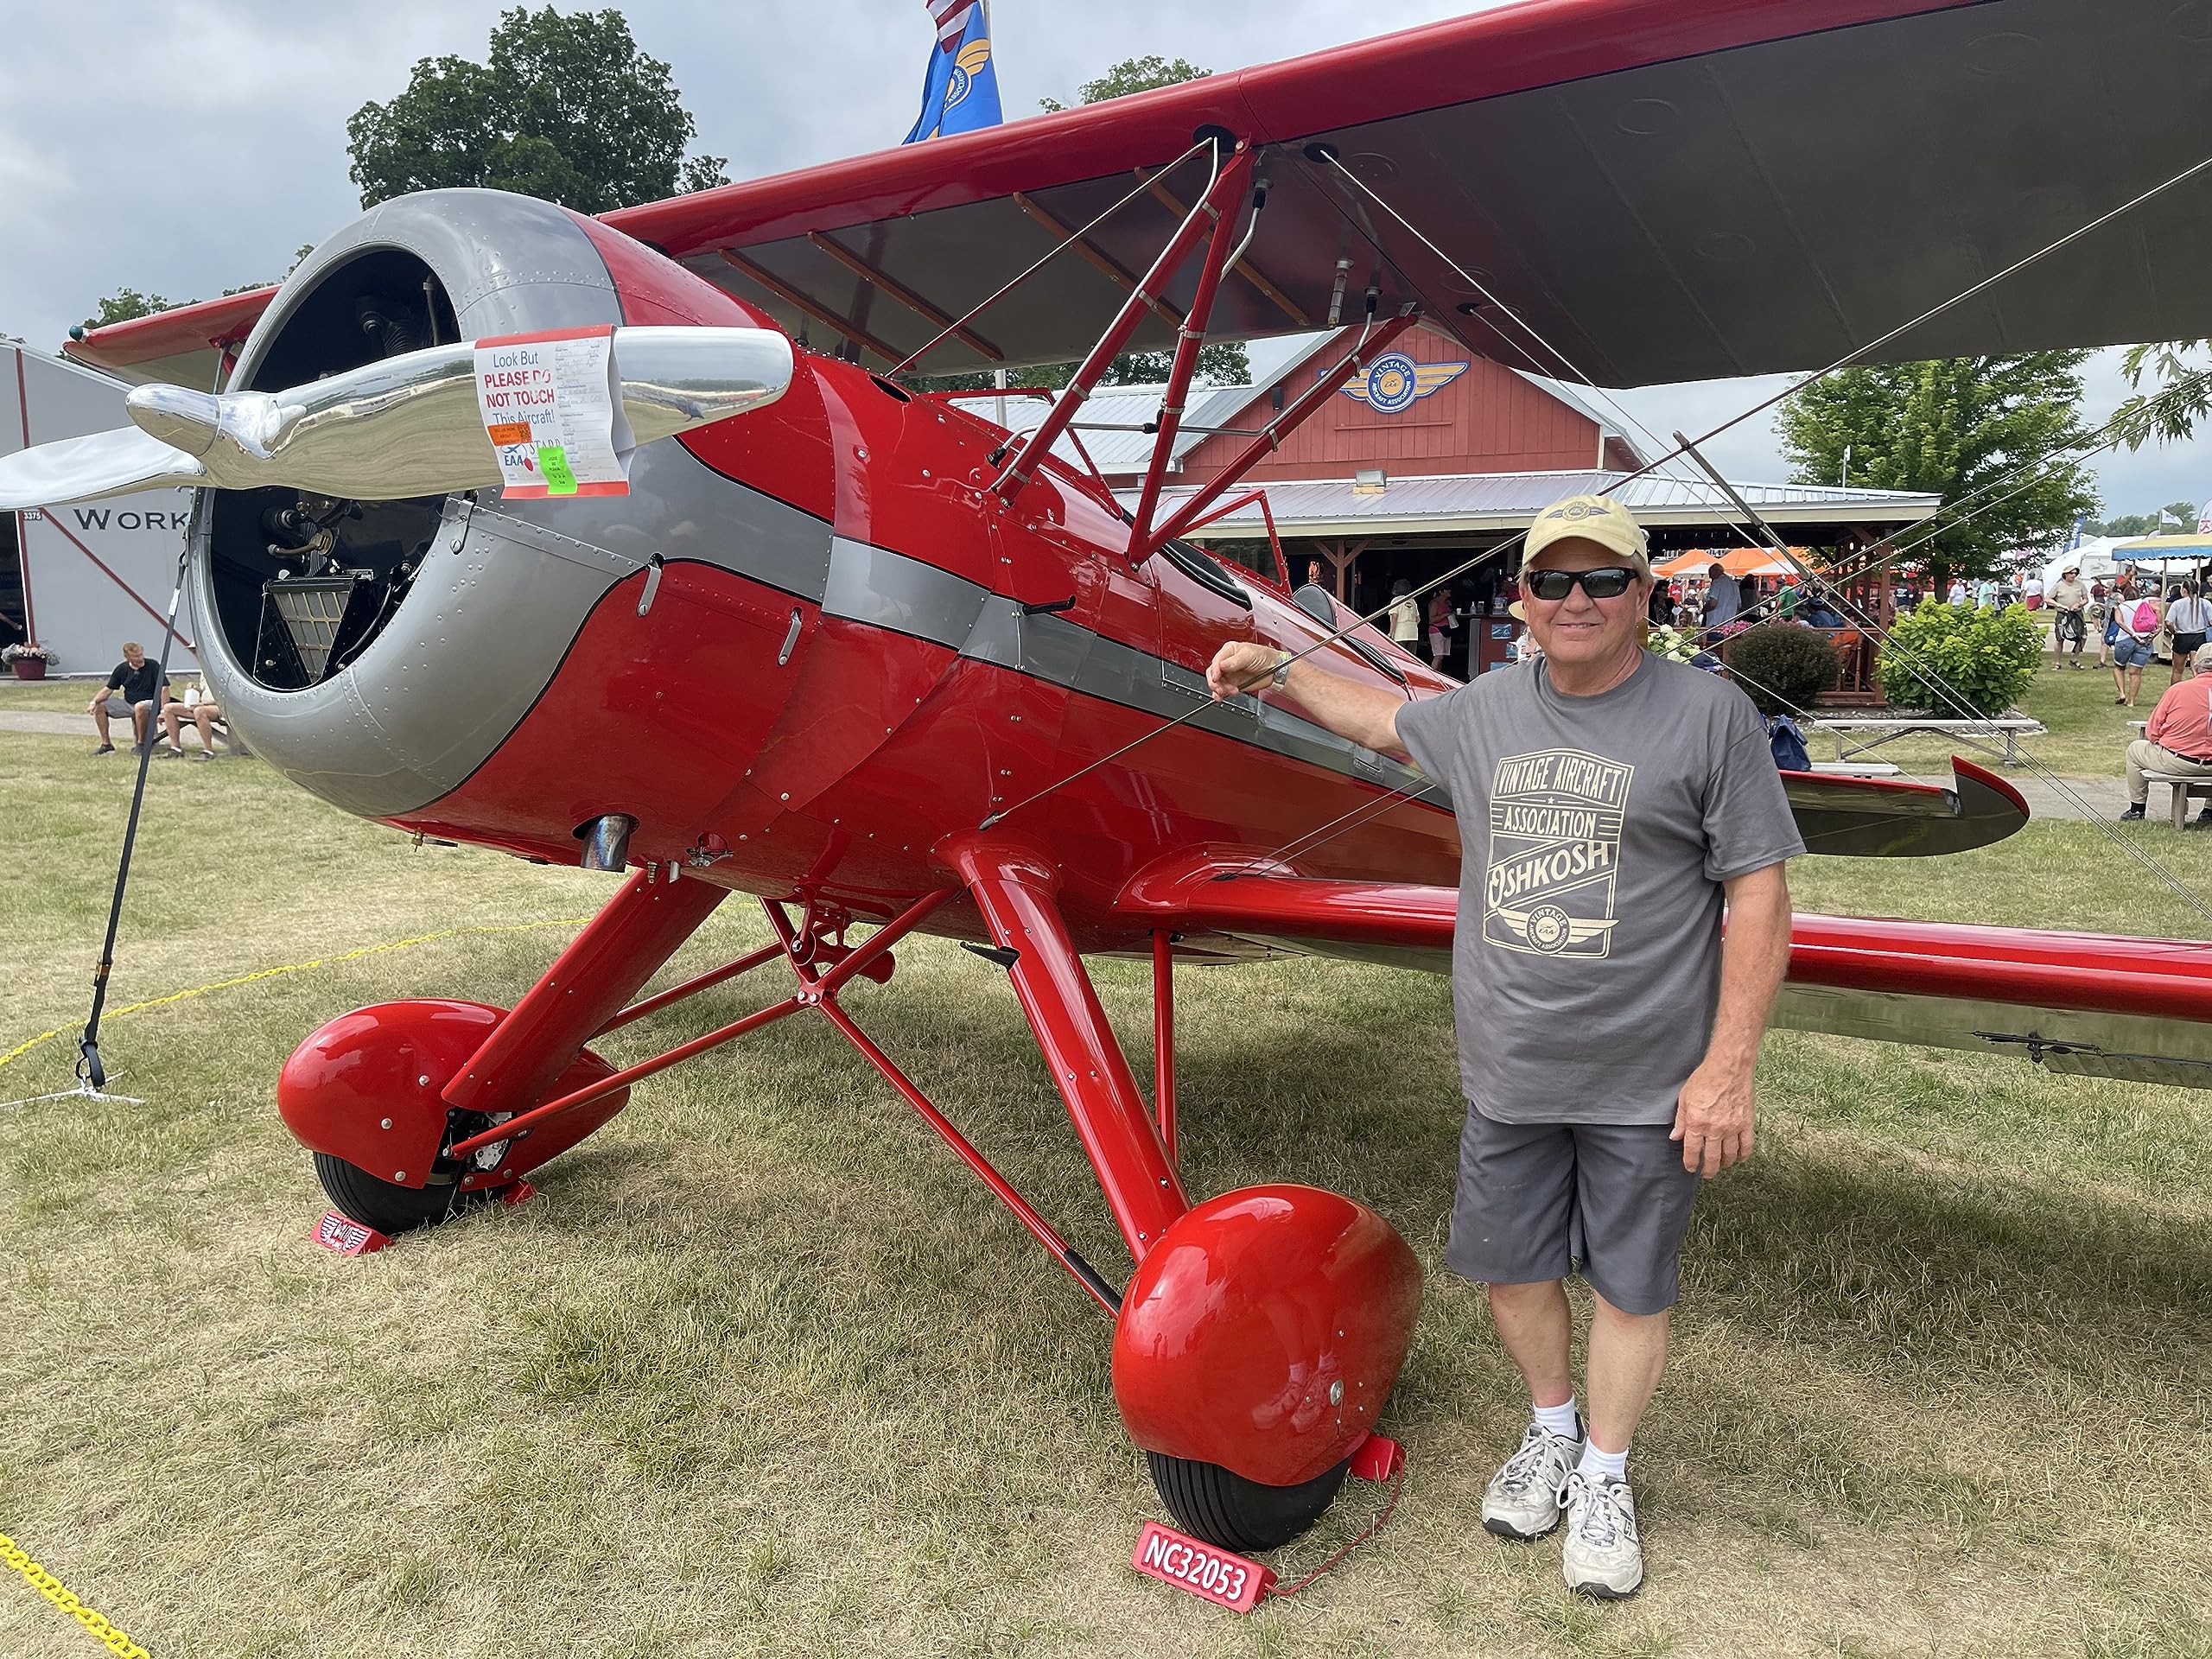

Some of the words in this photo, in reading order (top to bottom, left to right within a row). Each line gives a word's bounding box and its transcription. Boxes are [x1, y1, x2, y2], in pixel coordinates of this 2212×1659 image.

[493, 352, 518, 368] Look
[520, 350, 538, 365] But
[484, 371, 530, 389] PLEASE
[532, 368, 551, 385] DO
[1375, 361, 1411, 378] VINTAGE
[486, 391, 510, 408] NOT
[513, 388, 555, 406] TOUCH
[1387, 380, 1411, 404] ASSOCIATION
[493, 411, 516, 424] This
[518, 408, 555, 424] Aircraft!
[505, 454, 524, 467] EAA
[23, 512, 41, 520] 3375
[1497, 756, 1554, 794] VINTAGE
[1553, 756, 1622, 802] AIRCRAFT
[1503, 805, 1598, 838] ASSOCIATION
[1488, 840, 1610, 908] OSHKOSH
[1529, 908, 1567, 927] VINTAGE
[1541, 928, 1567, 949] ASSOCIATION
[1144, 1535, 1246, 1601] NC32053
